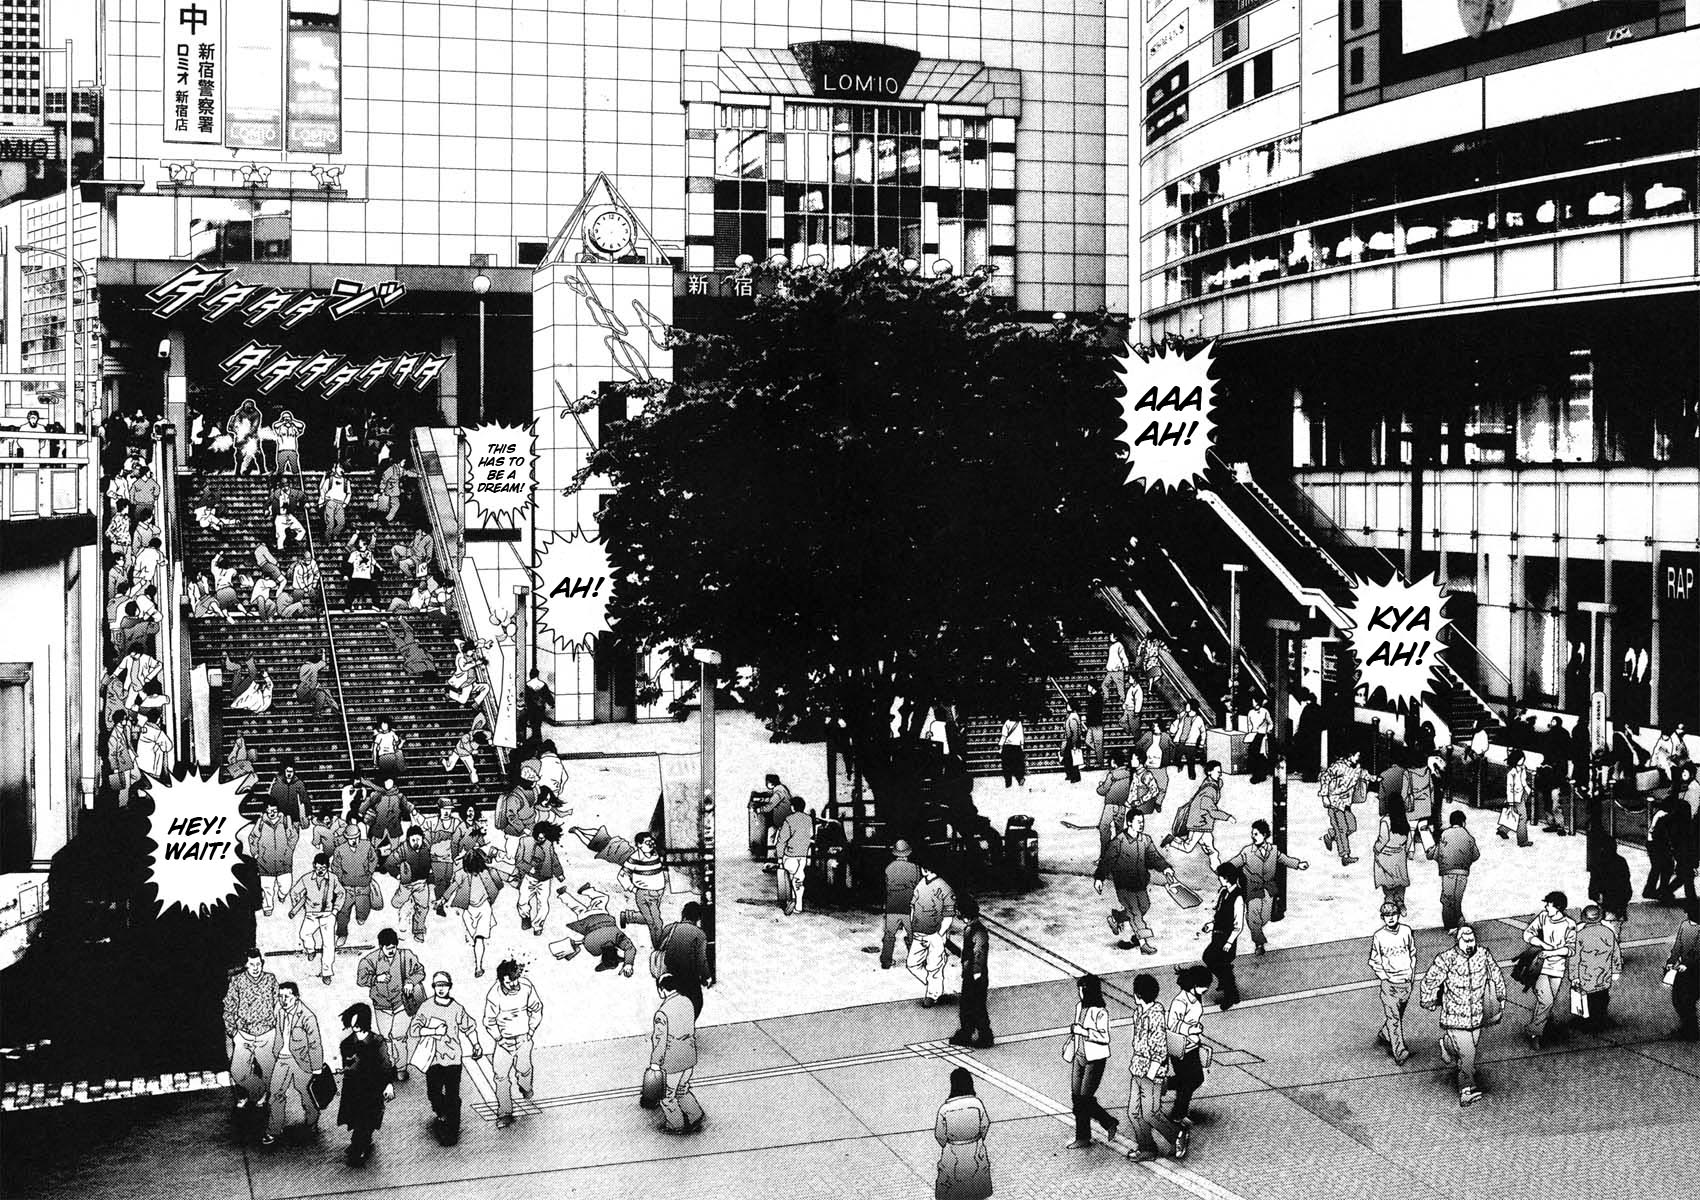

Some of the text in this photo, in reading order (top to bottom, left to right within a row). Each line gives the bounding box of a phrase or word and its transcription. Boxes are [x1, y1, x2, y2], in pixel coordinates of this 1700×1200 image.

[179, 2, 208, 36] 中
[175, 43, 189, 131] ロミオ 新宿店
[198, 42, 215, 134] 新宿警察署
[823, 73, 899, 95] LOMIO
[1667, 566, 1694, 599] RAP
